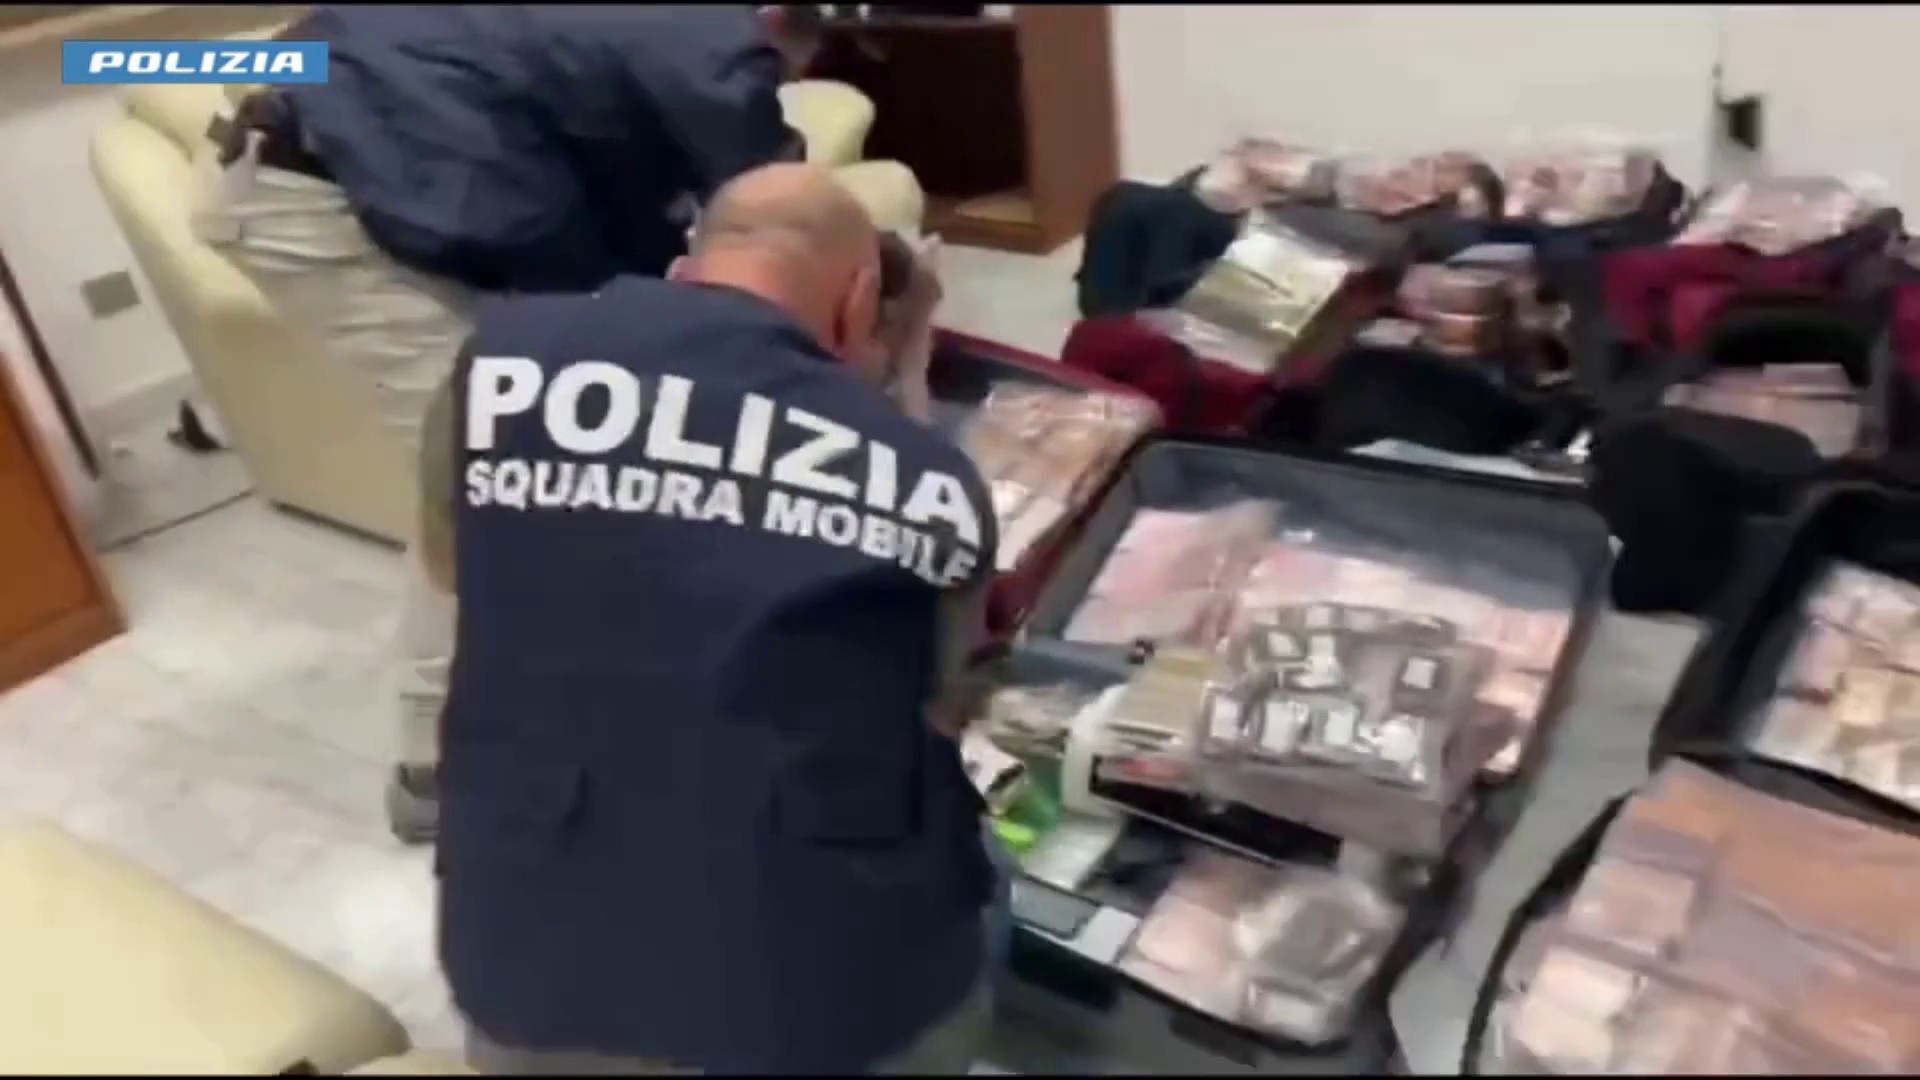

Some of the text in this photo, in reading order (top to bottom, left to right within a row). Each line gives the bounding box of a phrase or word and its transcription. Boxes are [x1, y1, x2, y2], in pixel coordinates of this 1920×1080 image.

[465, 459, 979, 589] SQUADRA MOBILE
[466, 356, 982, 551] POLIZIA
